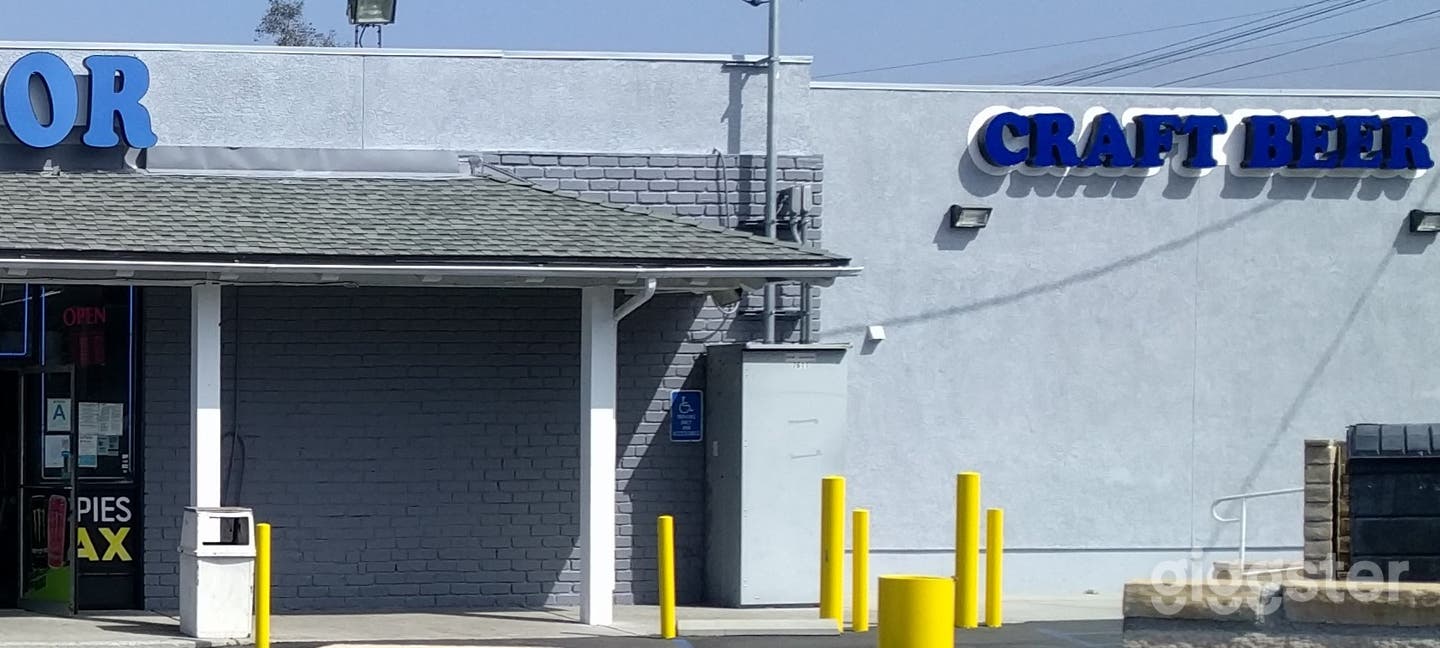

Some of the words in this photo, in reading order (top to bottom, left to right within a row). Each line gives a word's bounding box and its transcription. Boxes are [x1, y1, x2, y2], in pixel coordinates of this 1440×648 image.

[975, 111, 1227, 168] CRAFT
[1242, 114, 1434, 169] BEER
[62, 306, 107, 327] OPEN
[52, 404, 66, 421] A
